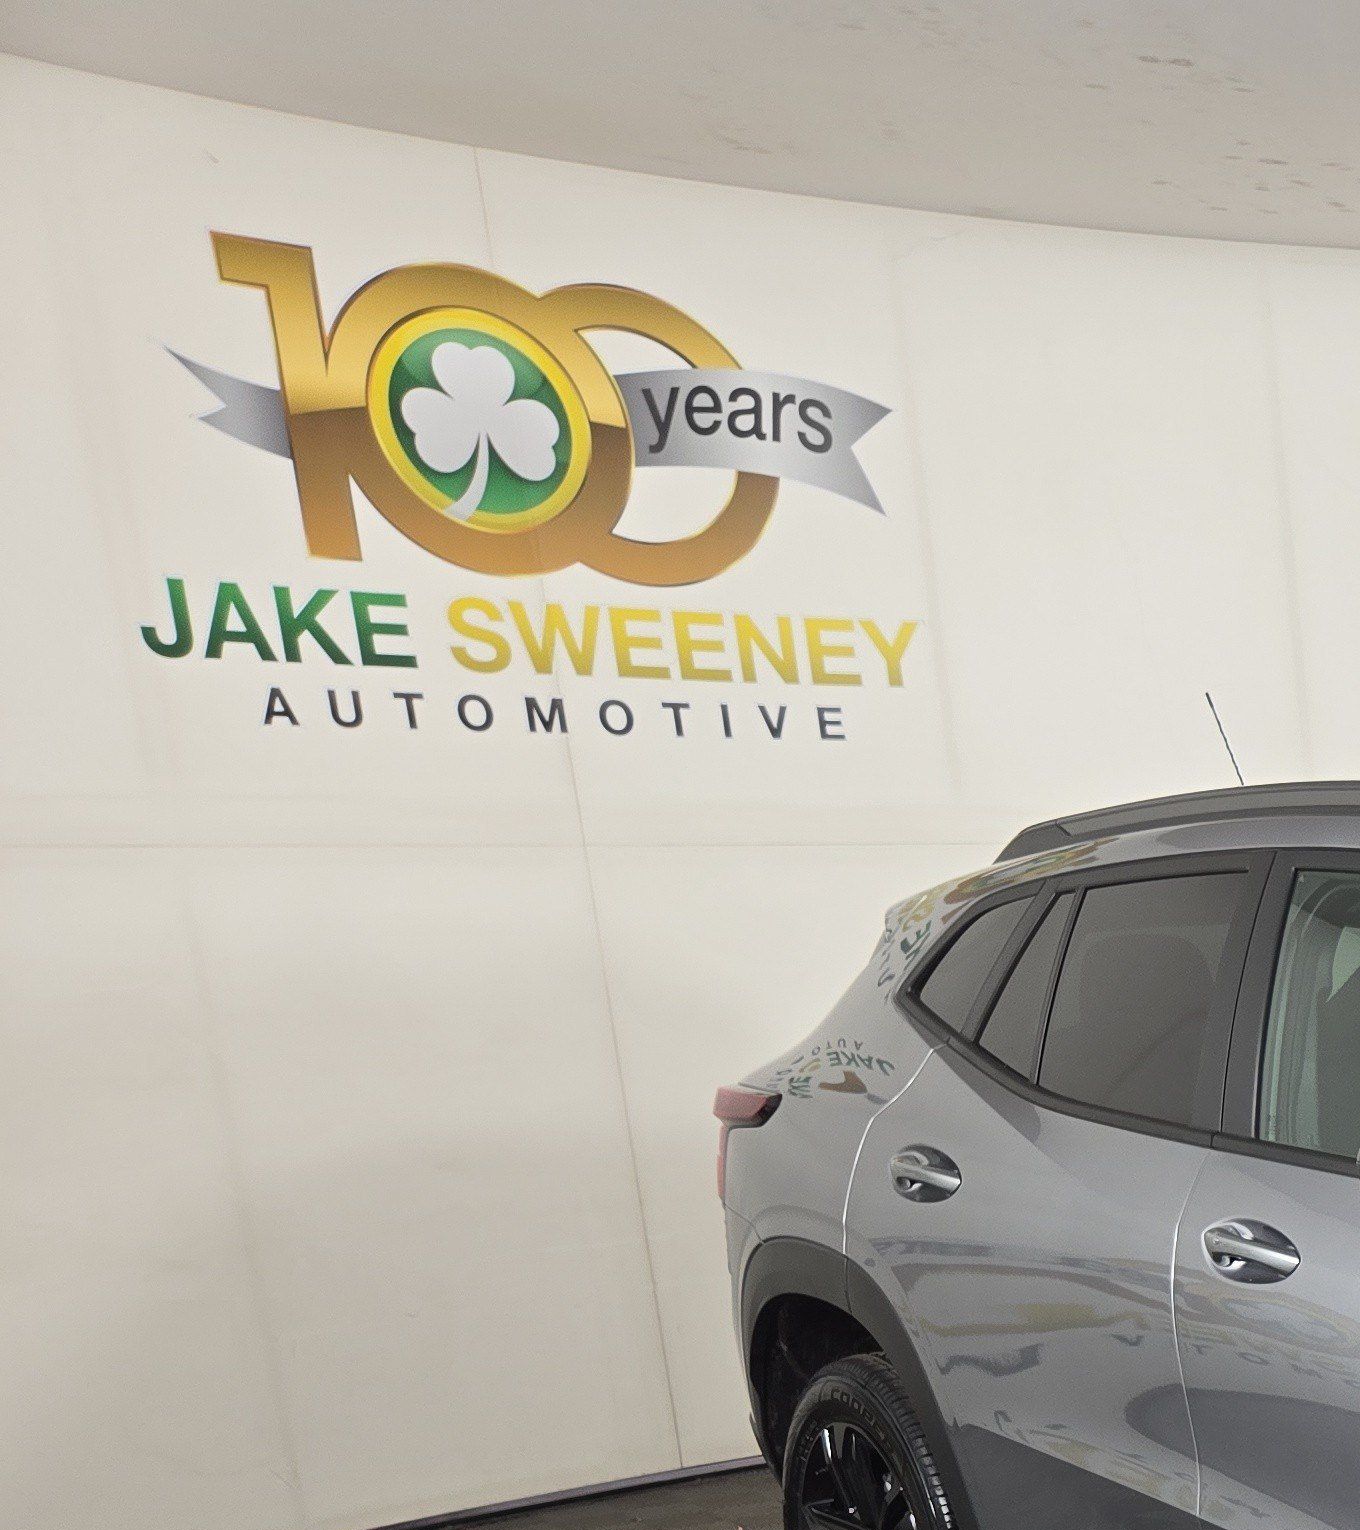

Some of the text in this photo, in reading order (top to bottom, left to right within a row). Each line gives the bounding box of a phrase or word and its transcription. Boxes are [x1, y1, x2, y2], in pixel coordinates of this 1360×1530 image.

[208, 230, 834, 587] 100 years
[140, 577, 918, 687] JAKE SWEENEY
[263, 686, 848, 741] AUTOMOTIVE
